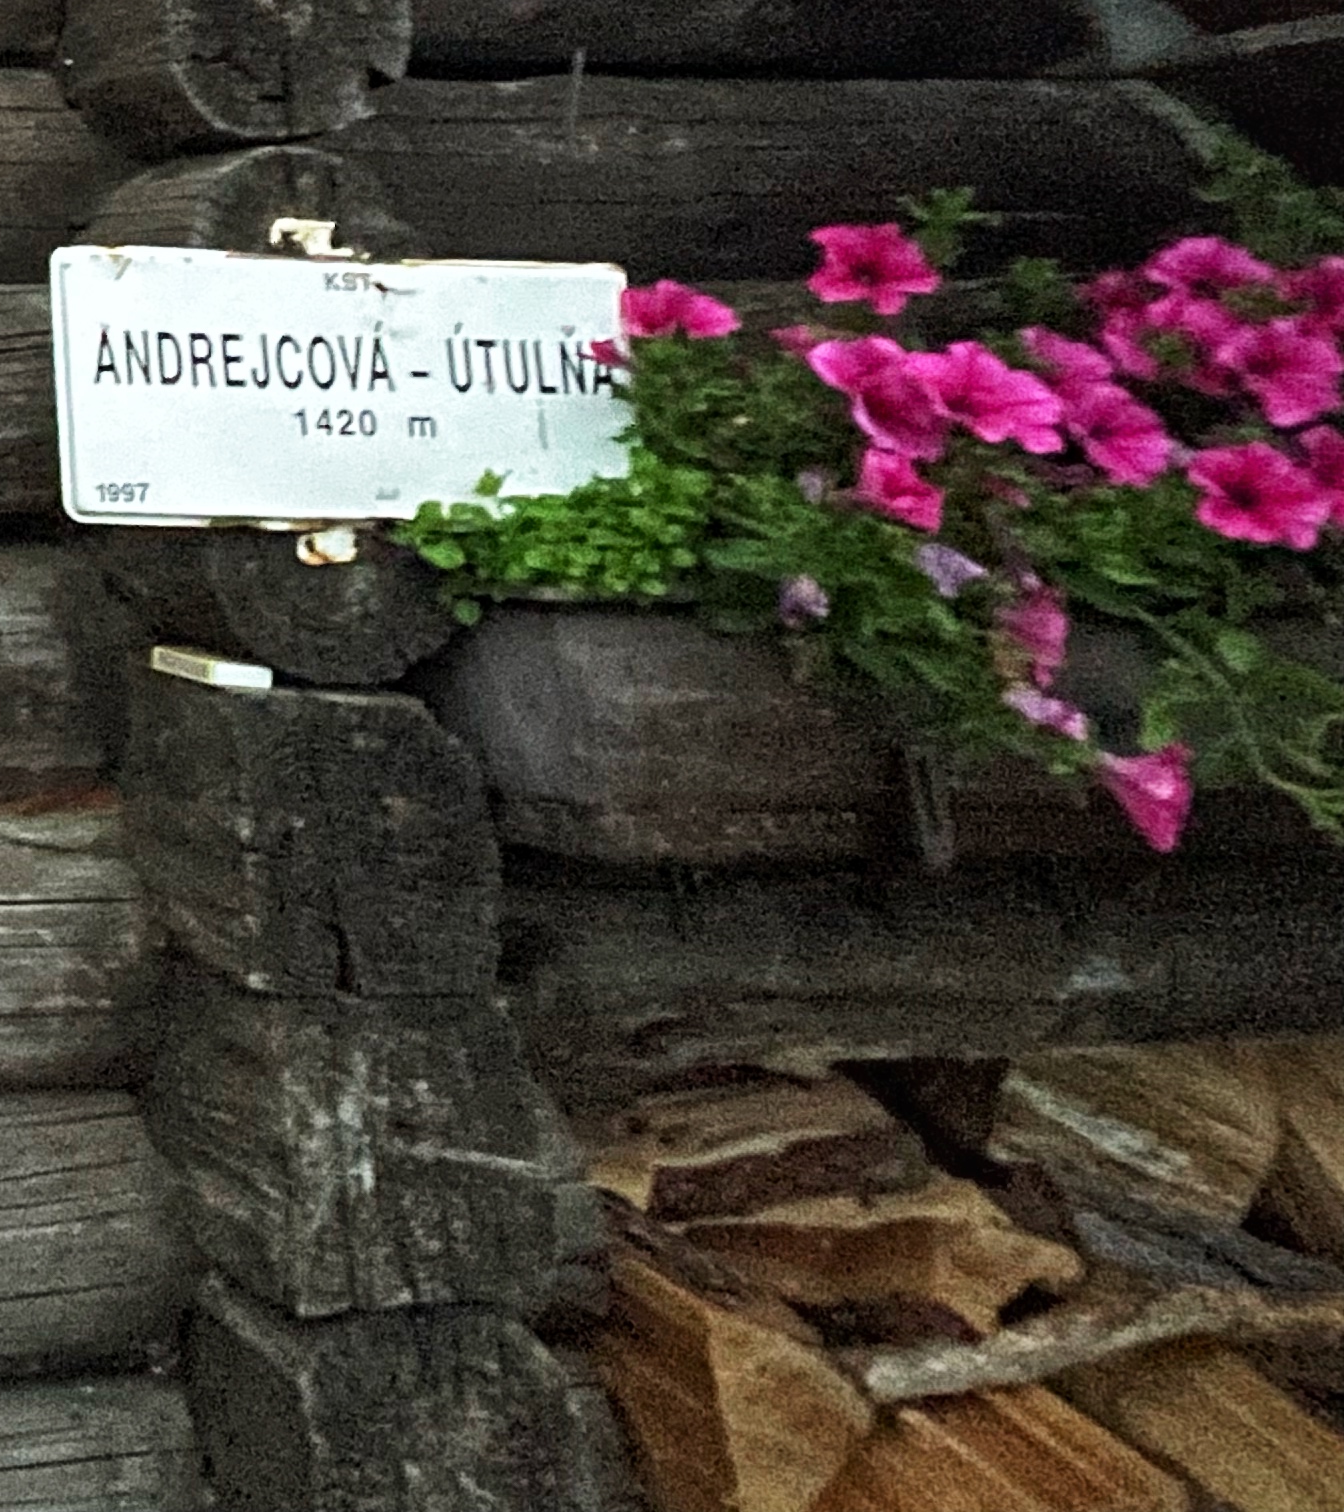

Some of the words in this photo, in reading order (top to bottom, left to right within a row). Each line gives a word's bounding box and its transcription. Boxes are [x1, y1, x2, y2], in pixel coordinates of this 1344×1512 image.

[293, 409, 378, 437] 1420
[408, 415, 438, 438] m
[95, 482, 151, 504] 1997
